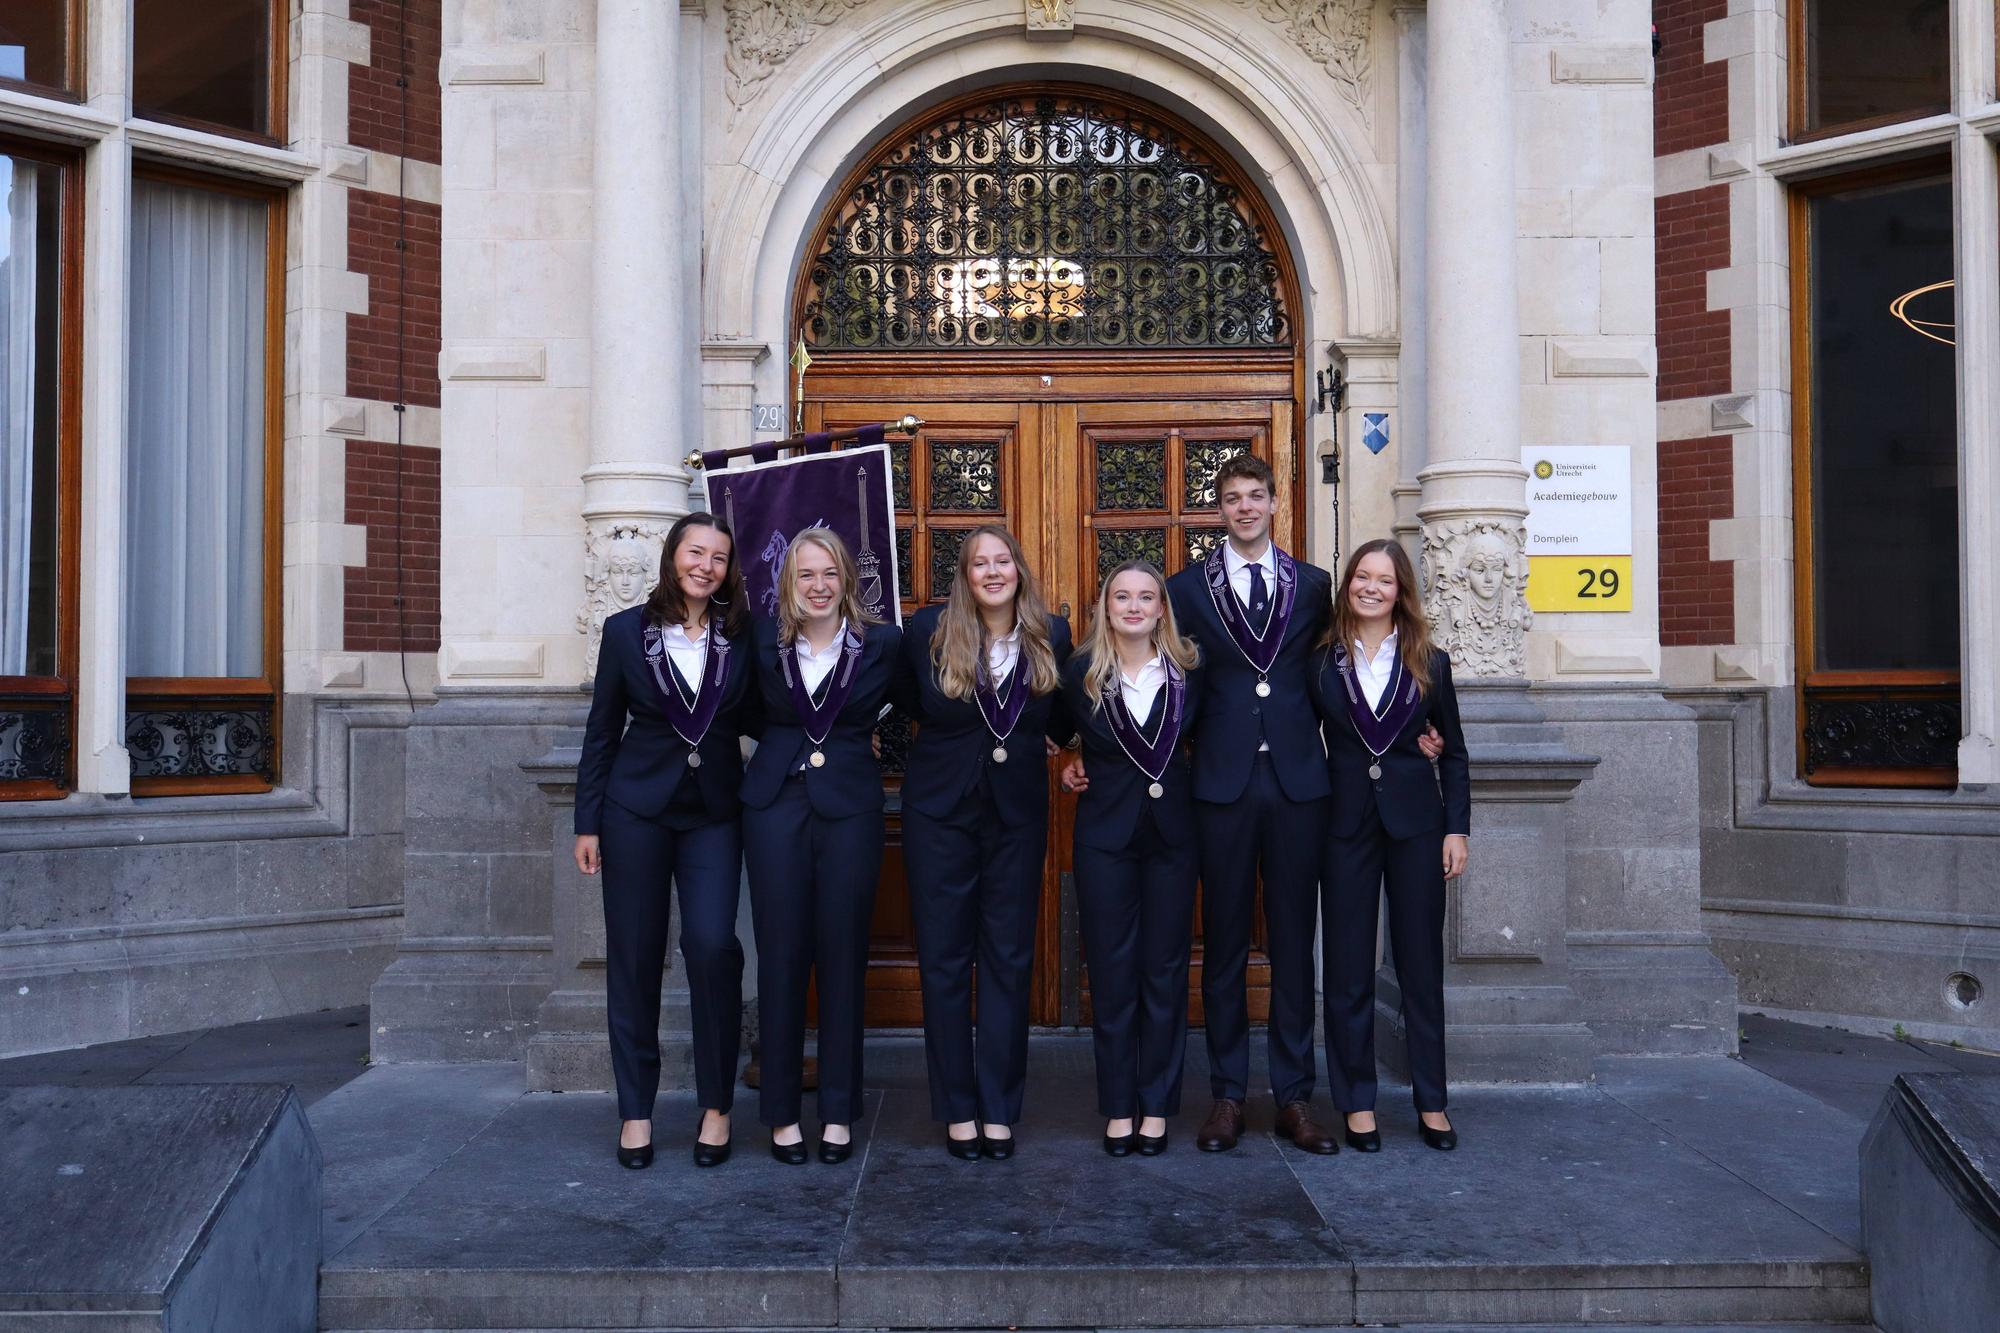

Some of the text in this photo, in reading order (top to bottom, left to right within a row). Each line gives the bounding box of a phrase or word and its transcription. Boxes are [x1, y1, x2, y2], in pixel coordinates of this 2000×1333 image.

[759, 407, 778, 429] 29
[1533, 492, 1618, 502] Academiegebouw
[1533, 535, 1578, 544] Domplein
[1577, 568, 1619, 598] 29
